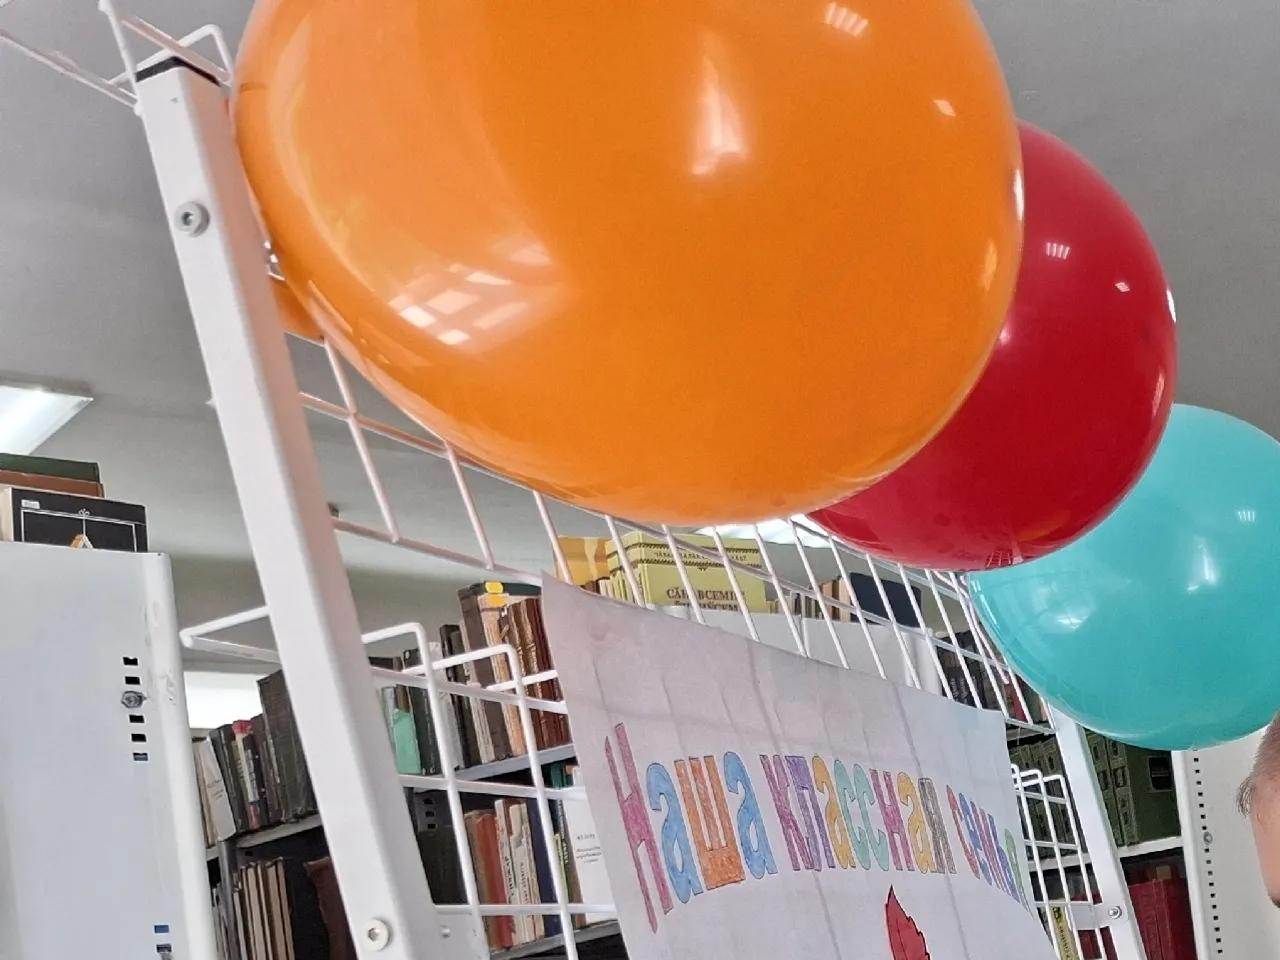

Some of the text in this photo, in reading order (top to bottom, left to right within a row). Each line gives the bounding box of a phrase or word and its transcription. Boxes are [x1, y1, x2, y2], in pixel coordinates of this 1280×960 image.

[604, 722, 779, 934] Наша
[758, 752, 957, 874] классная
[946, 784, 1035, 920] семья
